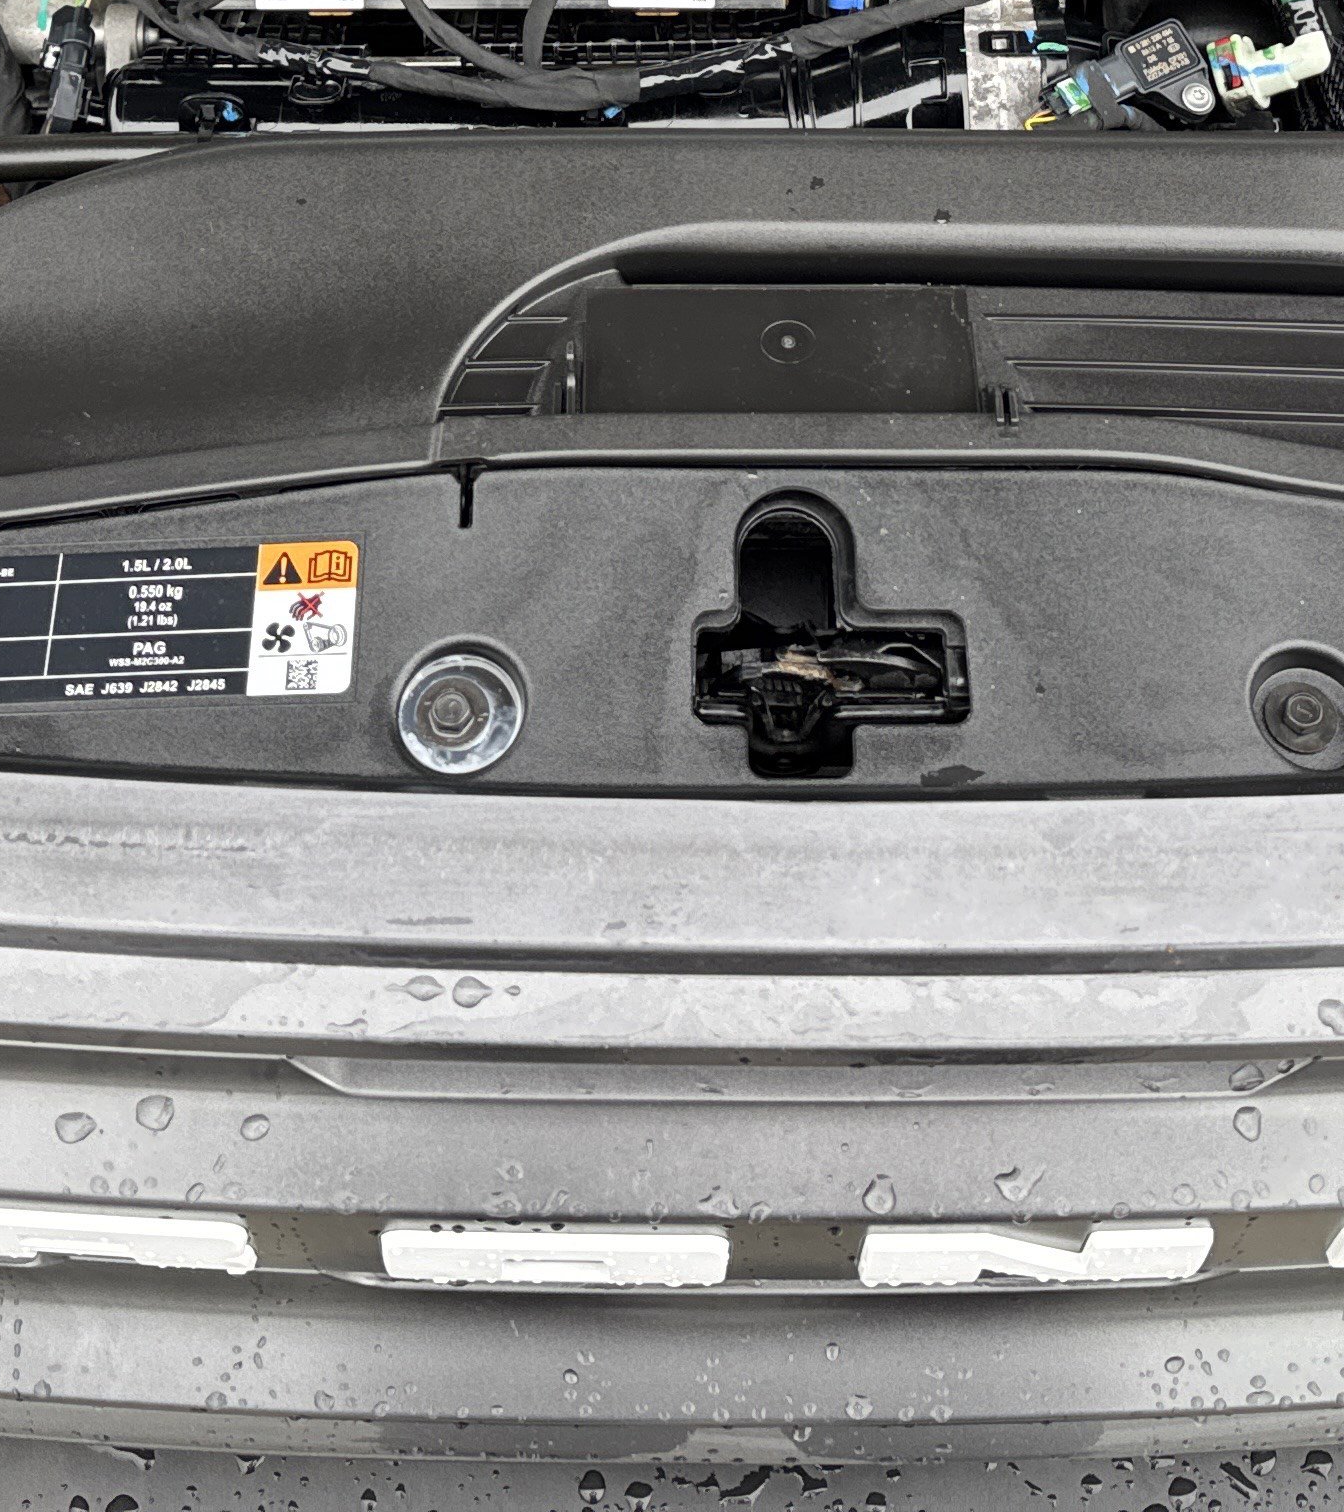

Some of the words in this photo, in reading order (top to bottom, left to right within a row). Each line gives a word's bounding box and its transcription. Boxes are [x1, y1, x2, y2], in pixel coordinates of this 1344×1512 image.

[122, 559, 152, 572] 1.5L
[153, 558, 161, 571] /
[162, 557, 192, 570] 2.0L
[128, 584, 163, 599] 0.550
[166, 584, 183, 600] kg
[134, 600, 156, 612] 19.4
[158, 602, 172, 611] oz
[127, 615, 154, 629] (1.21
[156, 614, 178, 627] lbs)
[132, 641, 166, 655] PAG
[64, 683, 94, 696] SAE
[100, 682, 134, 695] J639
[139, 680, 178, 693] J2842
[186, 678, 225, 691] J2845
